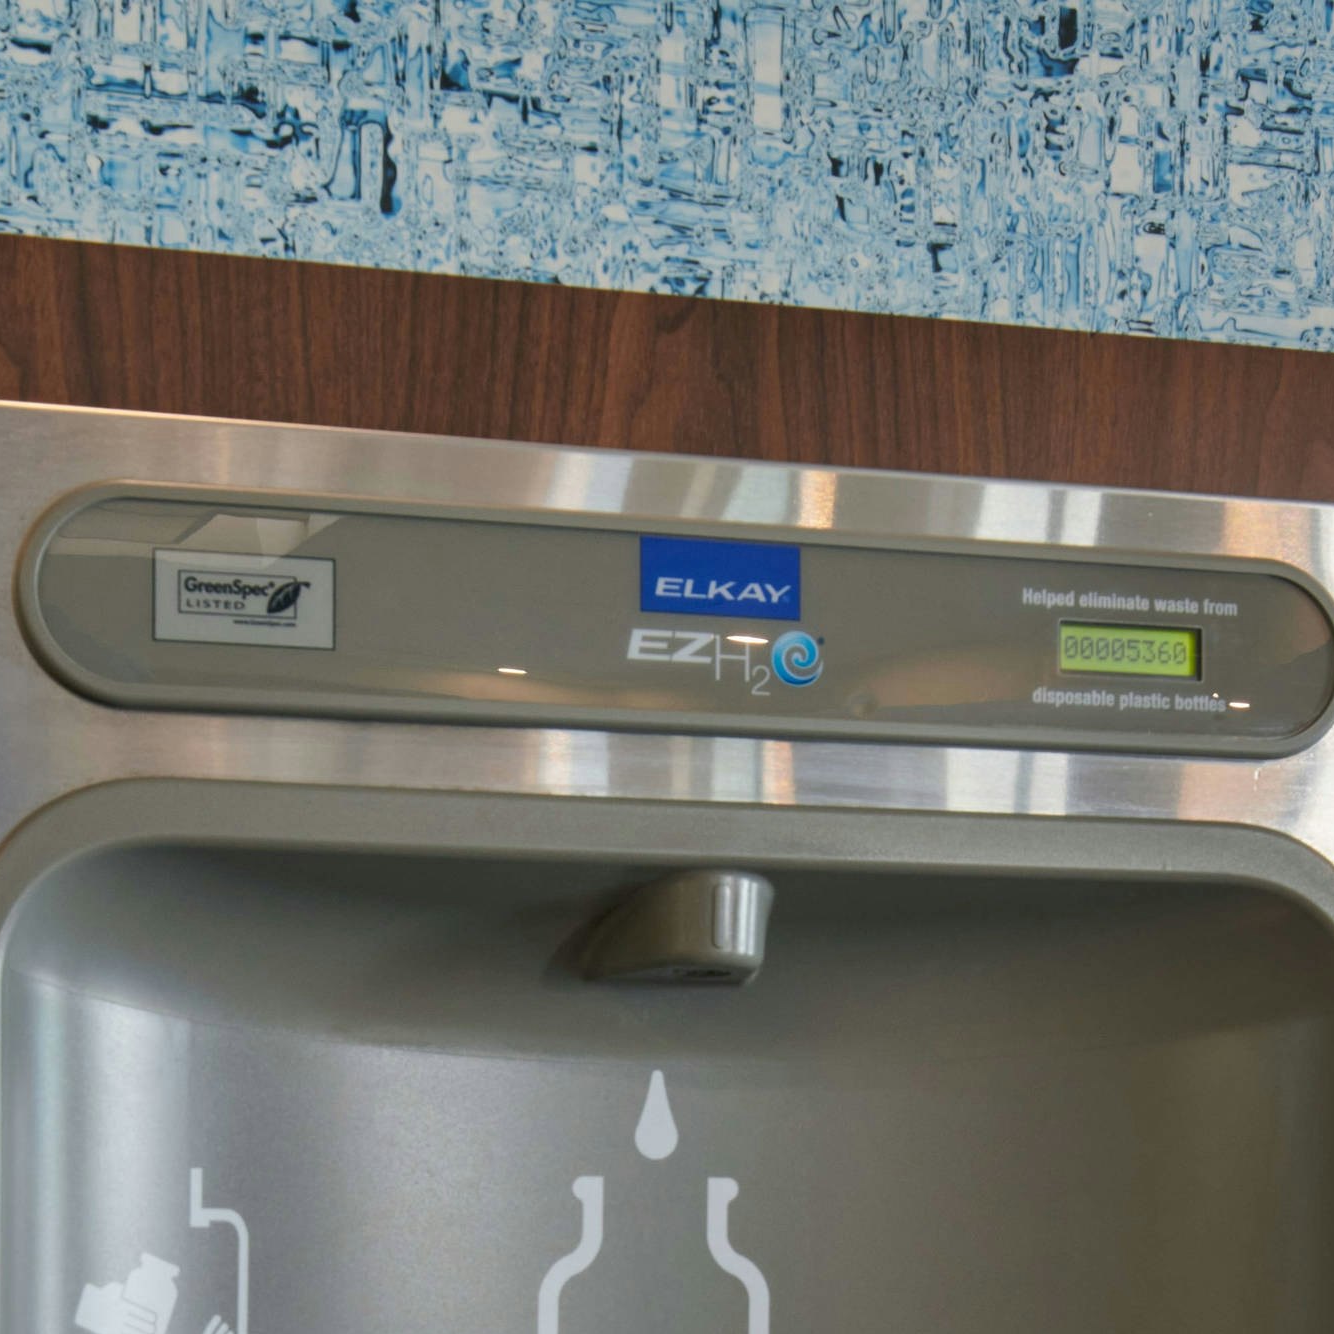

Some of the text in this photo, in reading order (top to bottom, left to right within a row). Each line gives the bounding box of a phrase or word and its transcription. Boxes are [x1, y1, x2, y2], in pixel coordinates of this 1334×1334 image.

[186, 598, 246, 610] LISTED
[655, 576, 792, 604] ELKAY
[1022, 587, 1238, 616] Helped eliminate waste from
[1064, 635, 1187, 665] 00005360
[1032, 687, 1227, 712] disposable plastic bottles
